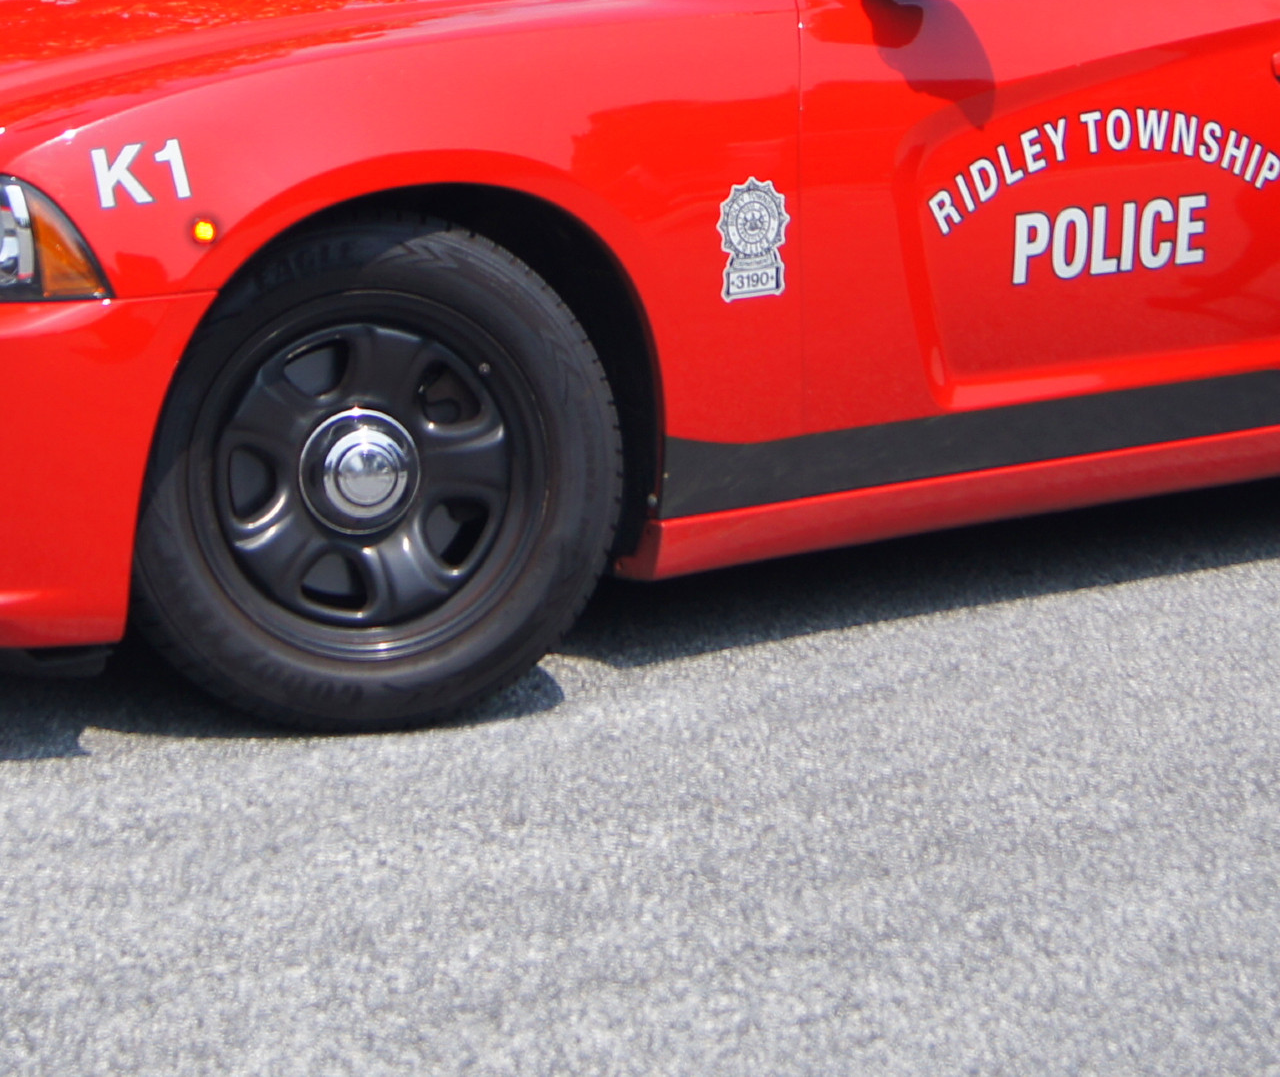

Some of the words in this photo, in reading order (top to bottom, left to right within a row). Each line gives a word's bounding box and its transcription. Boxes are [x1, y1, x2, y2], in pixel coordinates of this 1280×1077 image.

[90, 138, 193, 209] K1
[927, 117, 1067, 236] RIDLEY
[1012, 193, 1208, 285] POLICE
[736, 271, 769, 290] 3190
